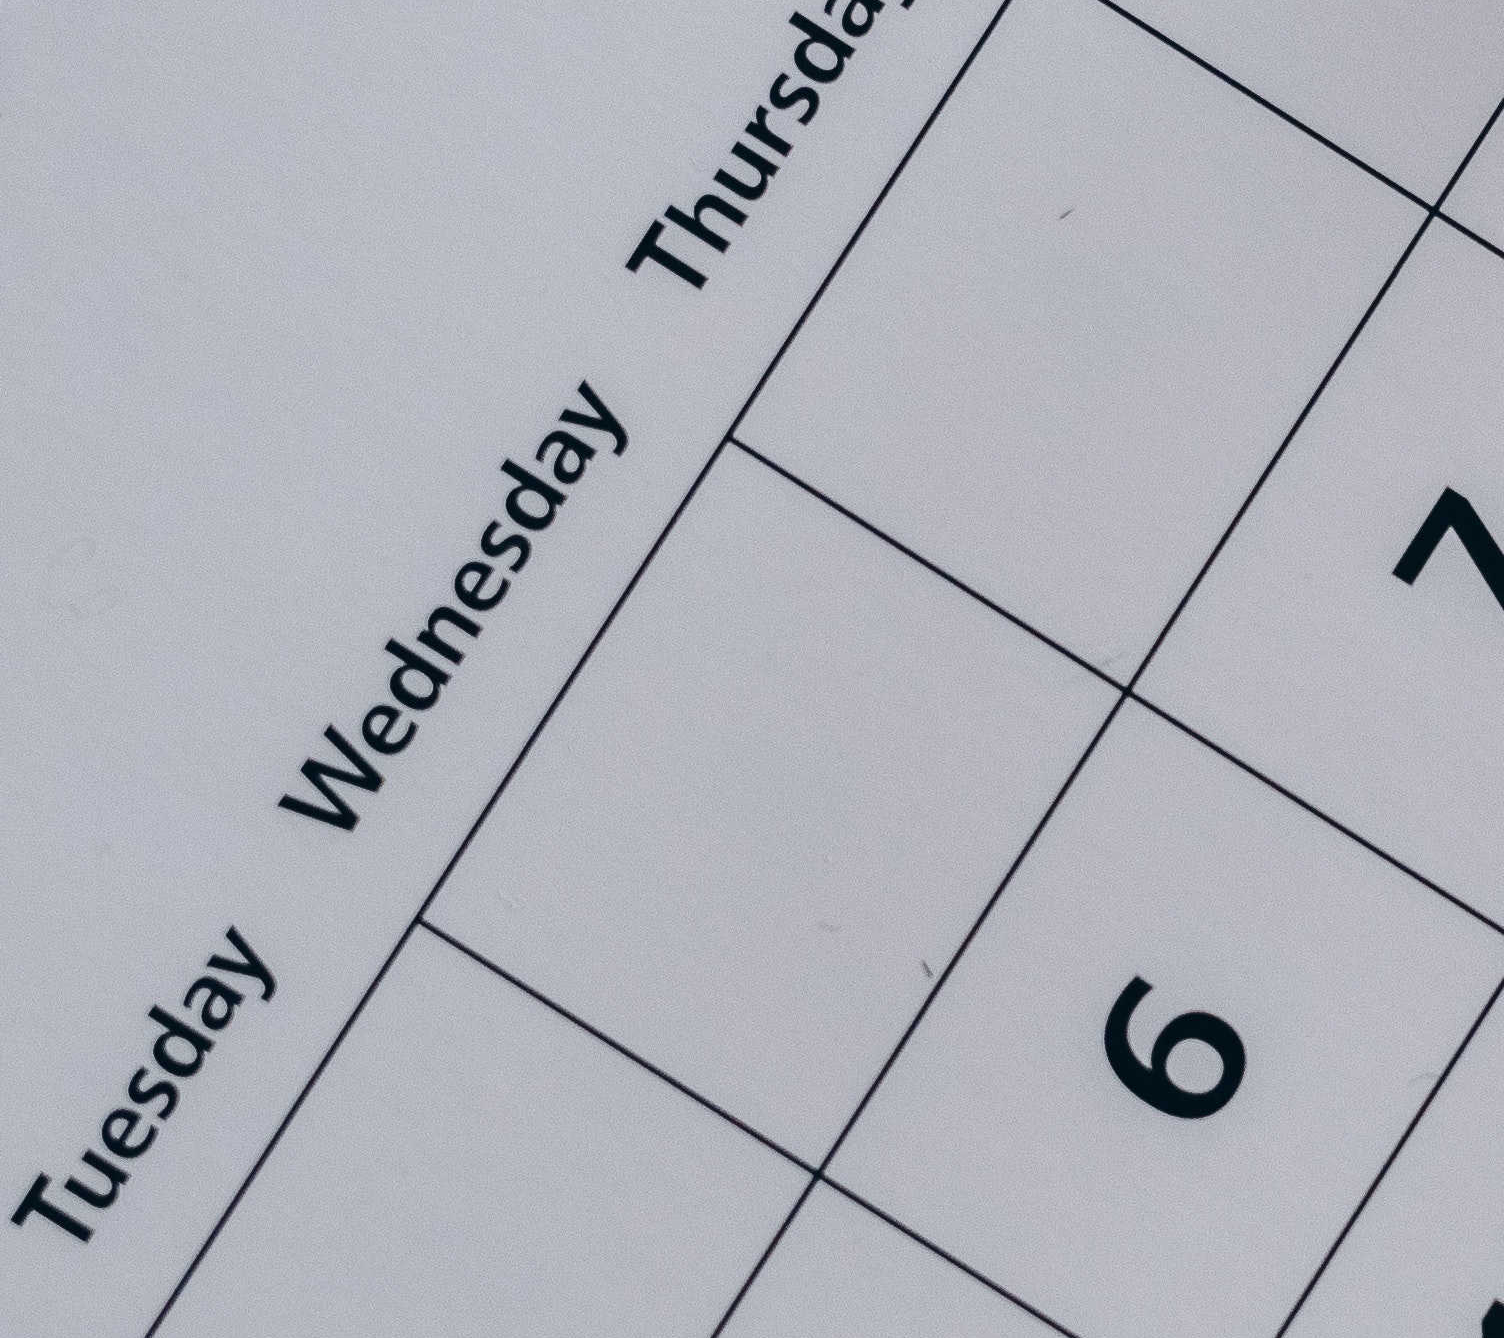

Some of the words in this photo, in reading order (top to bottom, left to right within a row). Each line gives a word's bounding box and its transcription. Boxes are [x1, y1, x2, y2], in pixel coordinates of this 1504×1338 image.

[278, 380, 628, 831] Wednesday
[11, 926, 275, 1242] Tuesday
[1104, 977, 1246, 1119] 6
